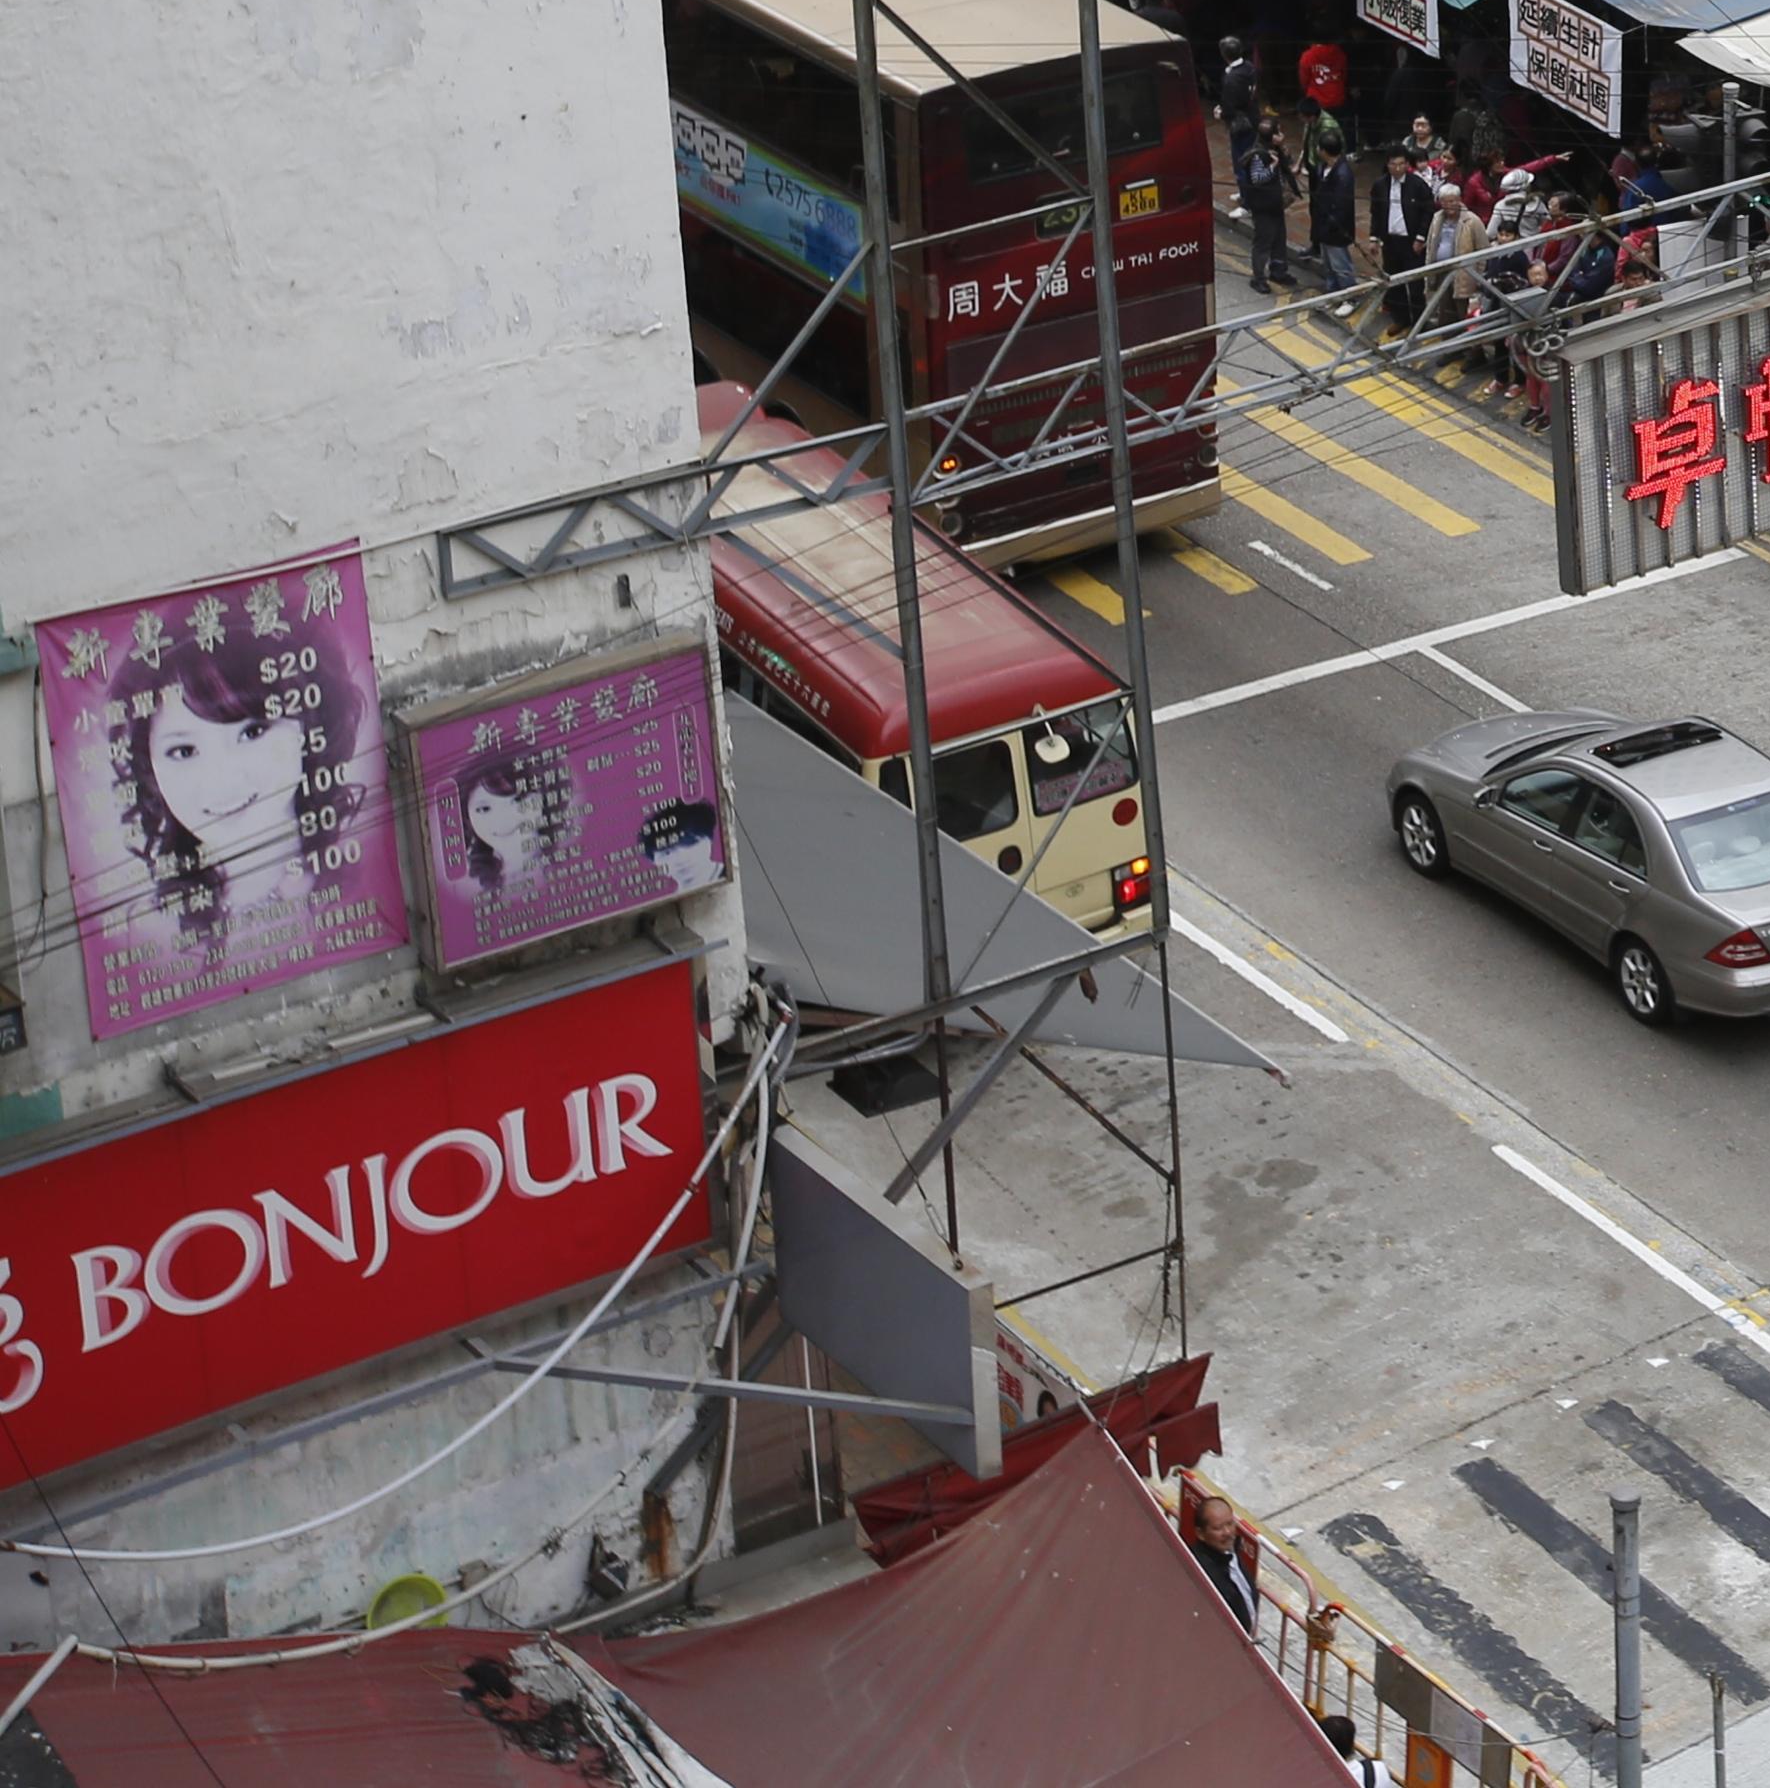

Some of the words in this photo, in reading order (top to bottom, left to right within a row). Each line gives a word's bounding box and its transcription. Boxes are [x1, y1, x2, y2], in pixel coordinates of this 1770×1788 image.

[1529, 48, 1609, 112] 保留社區
[1081, 257, 1124, 280] CHW
[1129, 254, 1154, 269] TAI
[1159, 241, 1200, 262] FOOK
[948, 259, 1069, 322] 周大福
[259, 646, 318, 684] $20
[264, 683, 322, 720] $20
[468, 673, 660, 755] 新專業髮廊
[632, 718, 660, 737] $25
[634, 739, 661, 758] $25
[642, 815, 678, 835] $100
[286, 839, 361, 878] $100
[70, 1073, 674, 1353] BONJOUR
